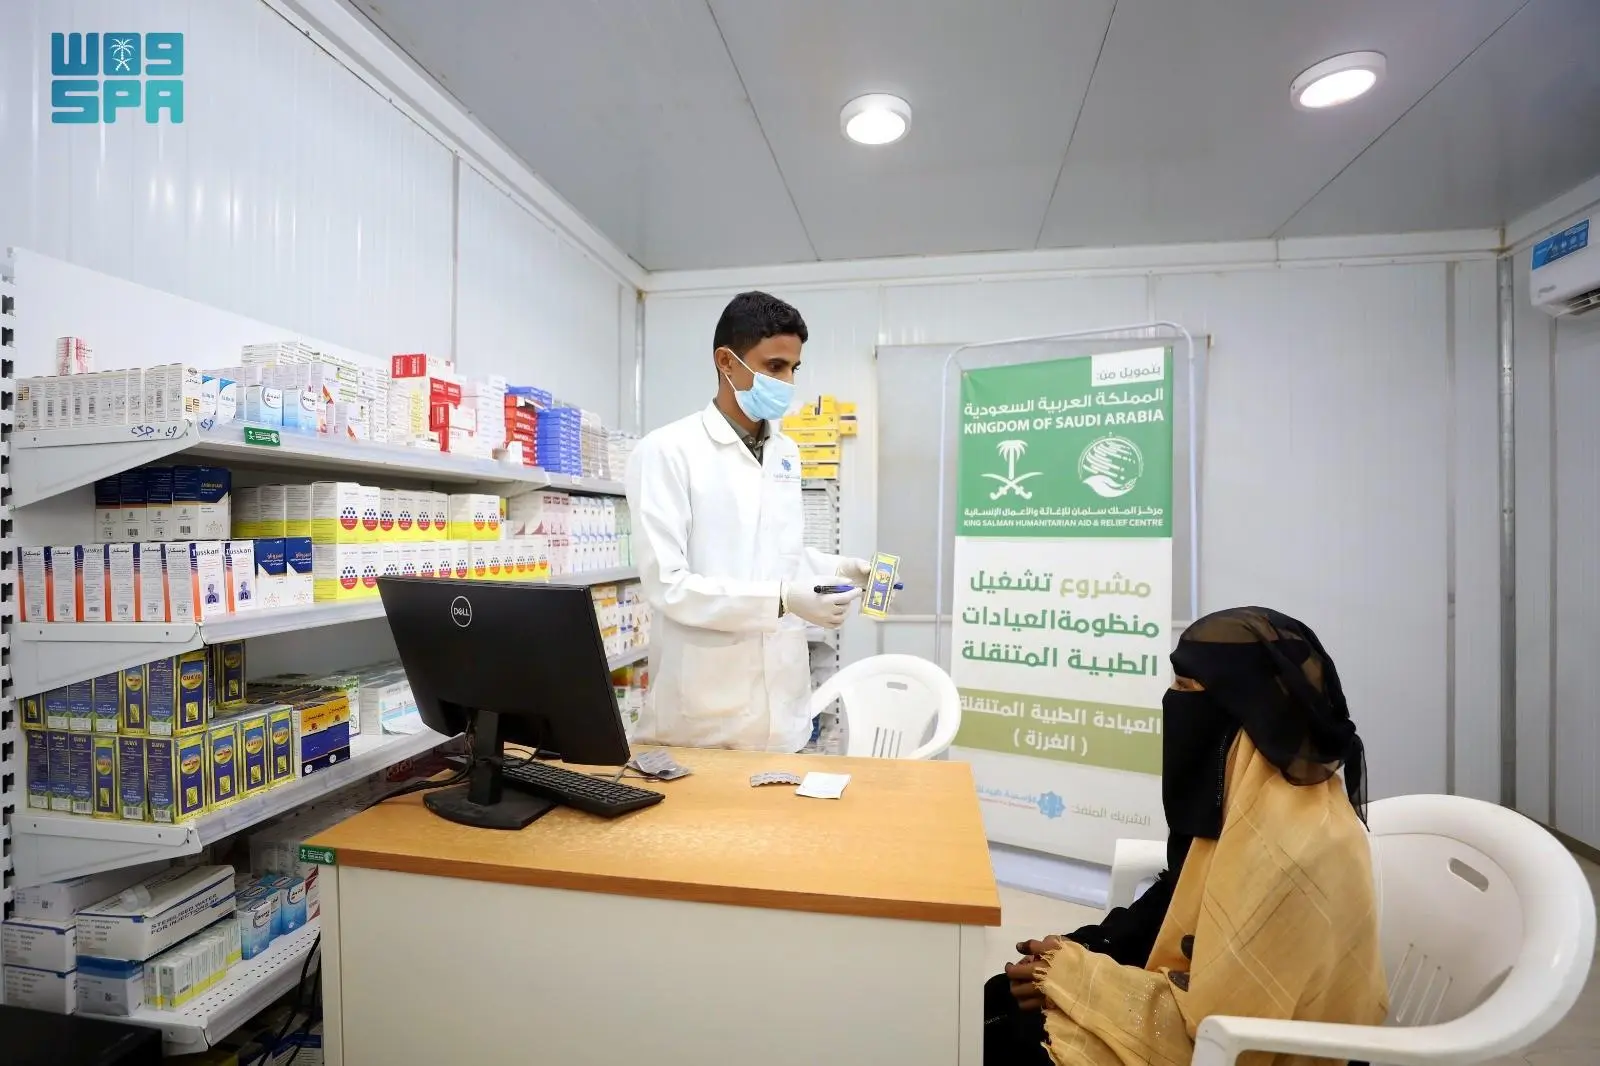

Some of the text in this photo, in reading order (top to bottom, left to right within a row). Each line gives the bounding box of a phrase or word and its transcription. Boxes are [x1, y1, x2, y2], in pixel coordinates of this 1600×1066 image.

[1120, 362, 1161, 379] بتمويل
[964, 388, 1164, 419] المملكة العربية السعودية
[964, 409, 1164, 435] KINGDOM OF SAUDI ARABIA
[1072, 507, 1107, 516] سلمان
[1108, 506, 1137, 516] الملك
[1138, 506, 1164, 516] مركز
[963, 519, 981, 527] KING
[982, 519, 1014, 527] SALMAN
[1016, 519, 1077, 527] HUMANITARIAN
[1078, 519, 1092, 527] AID
[1100, 519, 1128, 527] RELIEF
[1128, 519, 1164, 527] CENTRE
[191, 547, 220, 557] Tusskan
[225, 547, 252, 557] Tusskan
[970, 569, 1151, 599] مشروع تشغيل
[453, 607, 470, 617] DELL
[962, 606, 1160, 638] منظومة العيادات
[962, 640, 1158, 677] الطبية المتنقلة
[1030, 703, 1087, 726] الطبية
[1093, 711, 1161, 734] العيادة
[1110, 812, 1151, 827] الشريك
[194, 893, 217, 908] WATER
[150, 924, 168, 935] FOR
